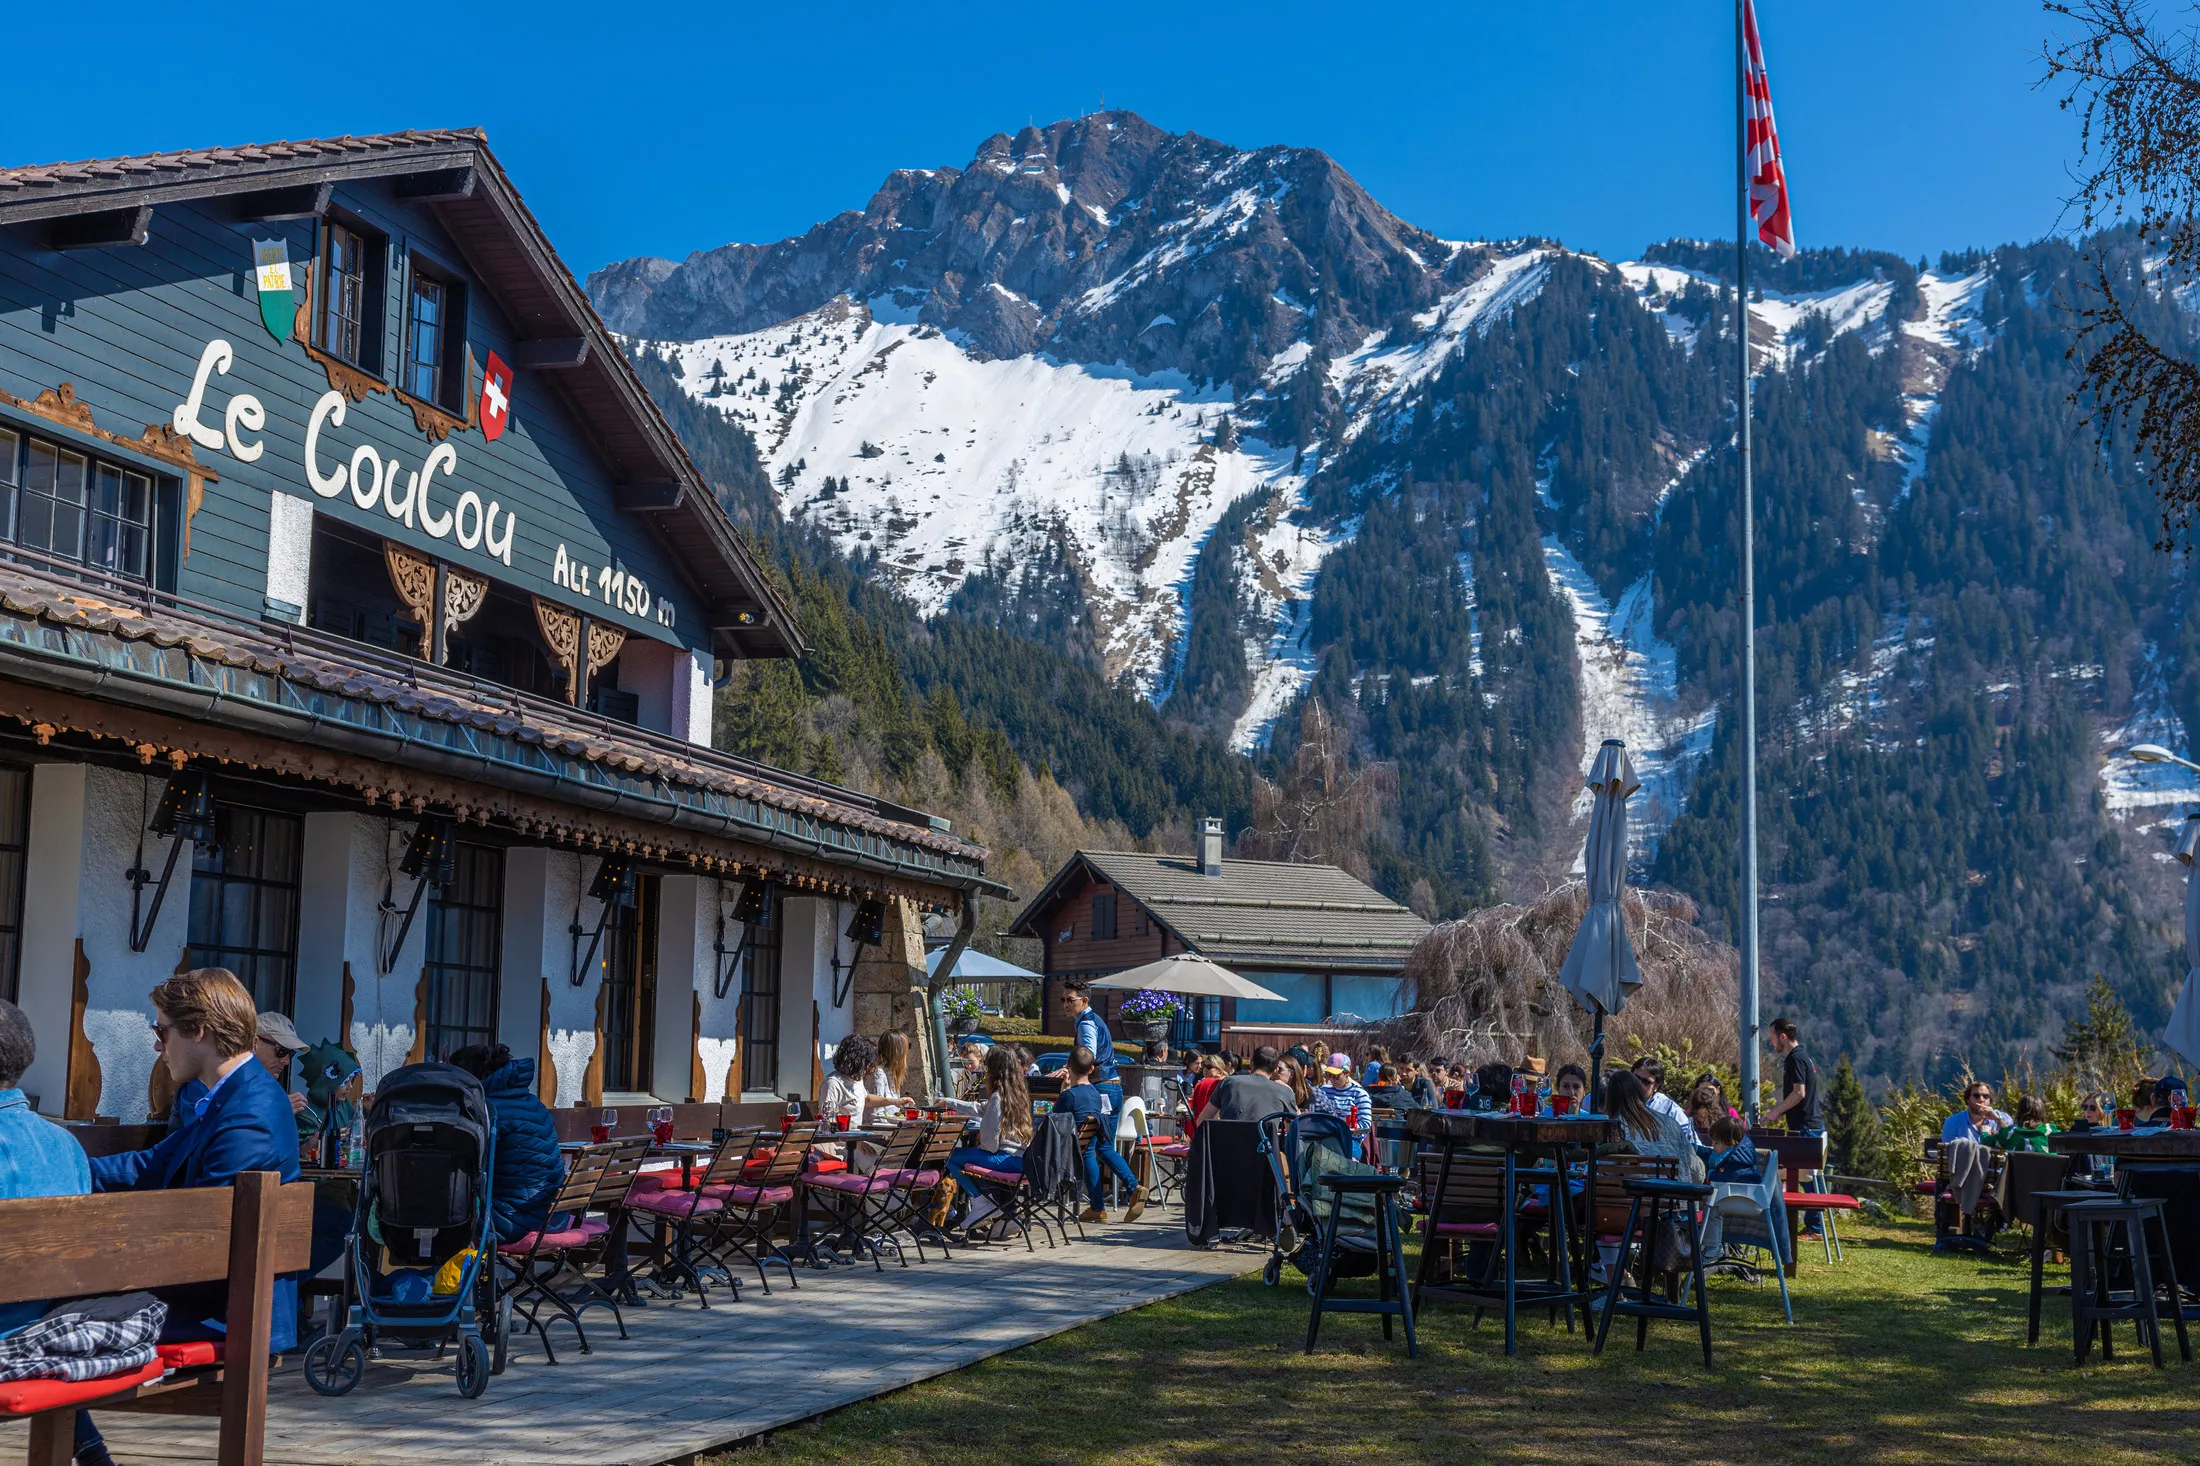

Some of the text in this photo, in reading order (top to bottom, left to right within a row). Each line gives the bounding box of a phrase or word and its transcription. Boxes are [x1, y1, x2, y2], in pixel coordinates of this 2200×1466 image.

[173, 339, 266, 462] Le
[598, 566, 650, 617] 1150
[657, 596, 675, 627] m
